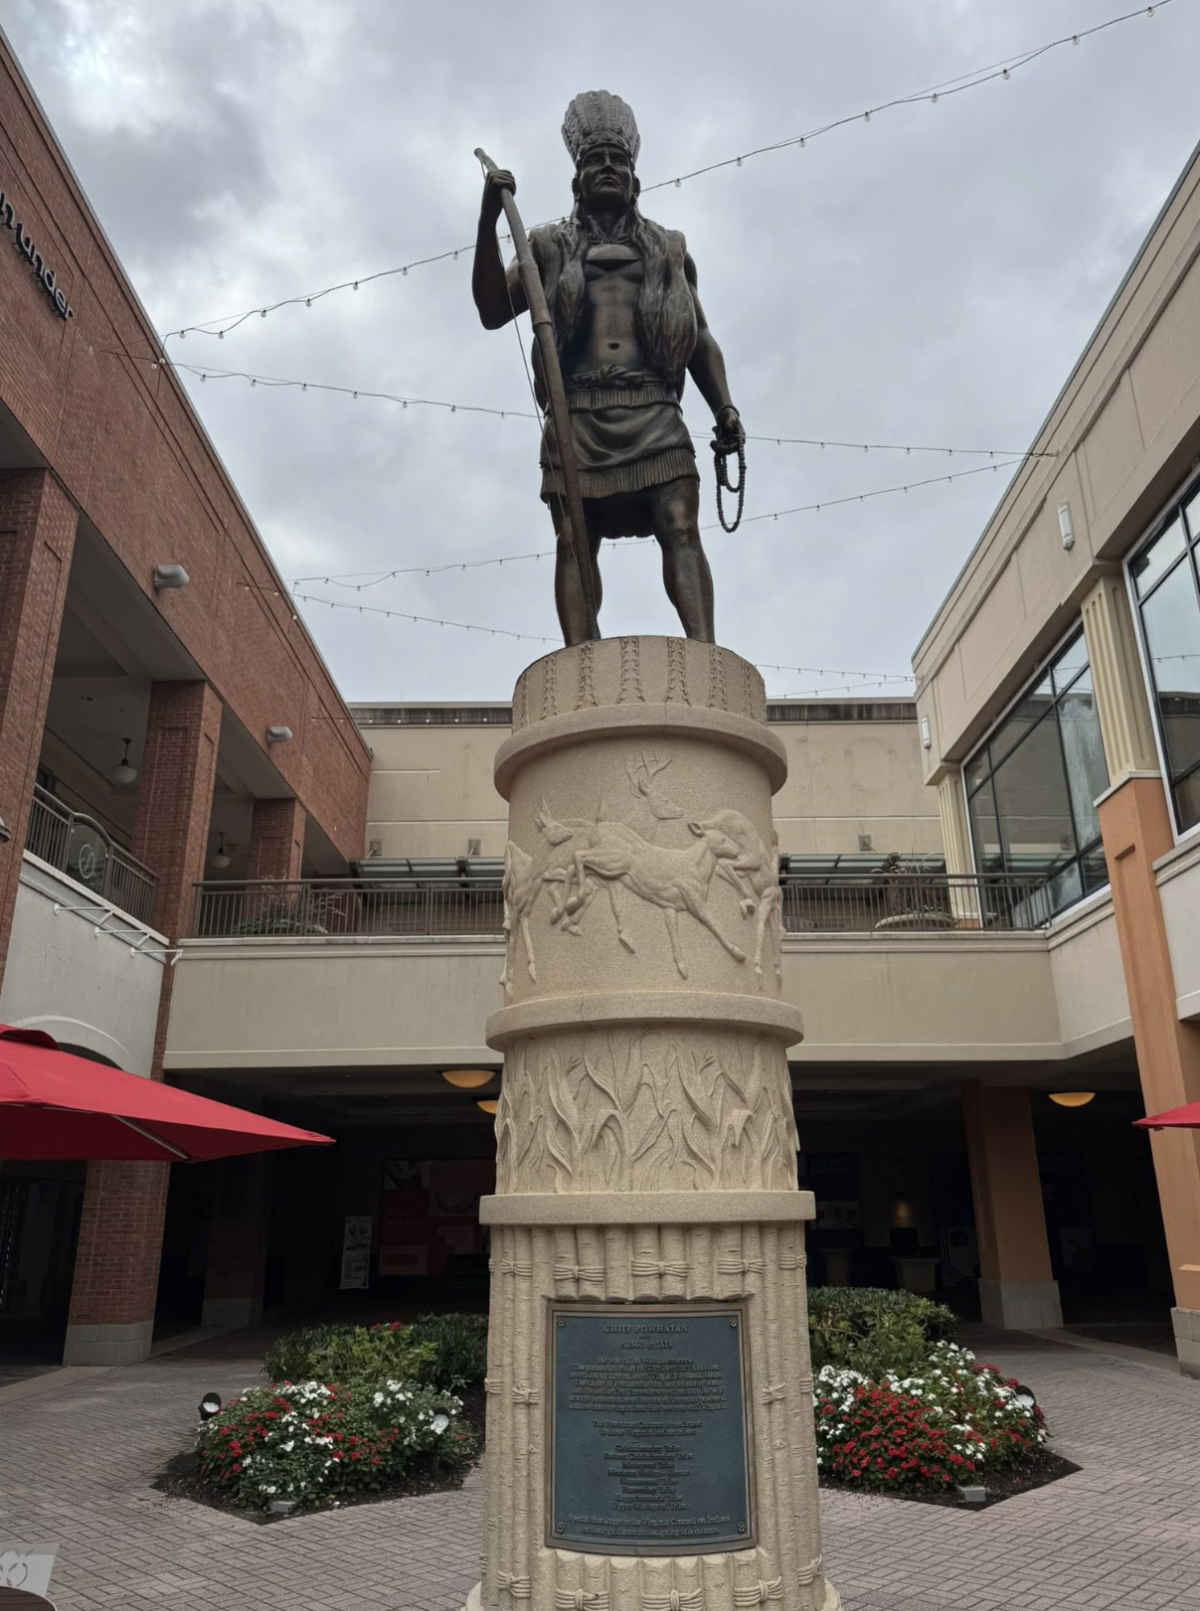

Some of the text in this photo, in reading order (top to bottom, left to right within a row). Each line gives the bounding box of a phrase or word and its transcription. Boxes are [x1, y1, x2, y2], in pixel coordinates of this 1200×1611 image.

[604, 1324, 689, 1334] CHIEF POWHATAN
[569, 1513, 730, 1528] Special thanks go to the Virginia Council on Indians
[646, 1527, 680, 1539] designing
[680, 1525, 693, 1536] this
